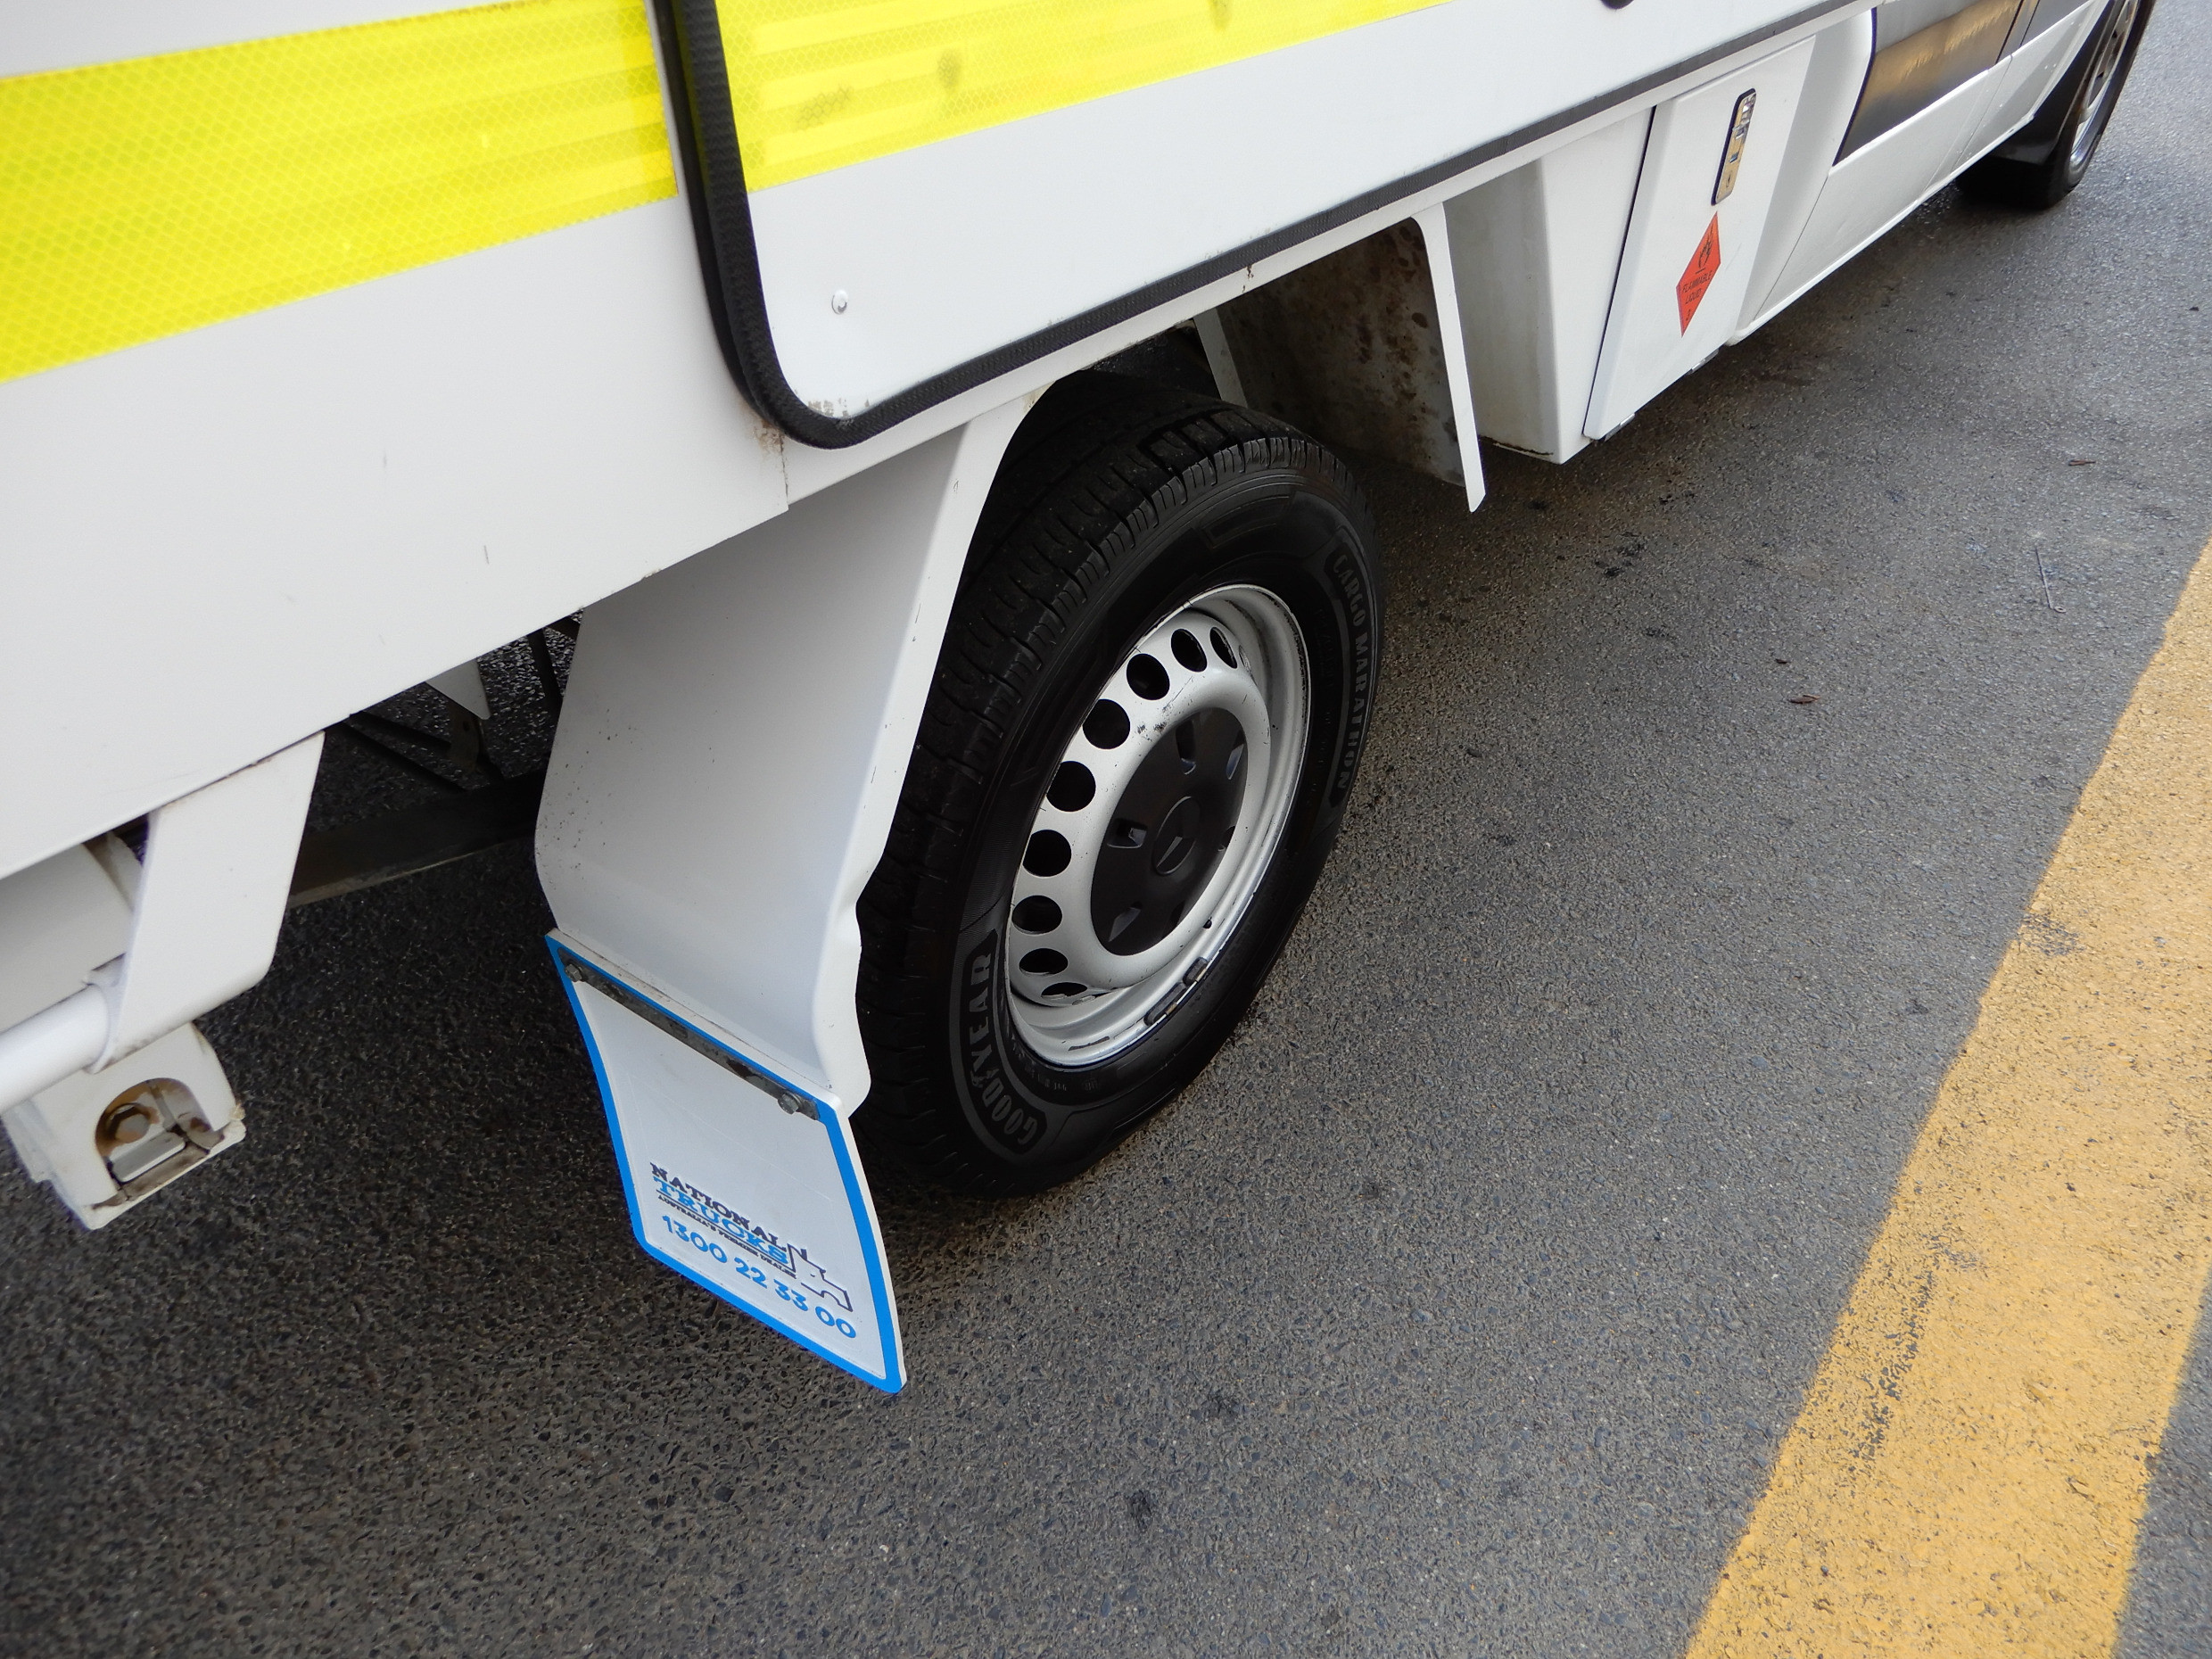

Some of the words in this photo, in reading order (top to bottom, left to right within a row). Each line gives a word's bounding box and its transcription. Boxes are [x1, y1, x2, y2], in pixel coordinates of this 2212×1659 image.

[1682, 270, 1713, 293] FLAMMABLE
[1685, 288, 1702, 304] LIQUID
[1333, 553, 1366, 627] CARGO
[1337, 631, 1369, 790] MARATHON
[970, 953, 1038, 1145] GOODYEAR
[649, 1161, 787, 1251] NATIONAL
[653, 1176, 788, 1265] TRUCKS
[658, 1194, 716, 1232] AUSTRALIA'S
[662, 1215, 727, 1263] 1300
[733, 1257, 768, 1289] 22
[773, 1278, 809, 1311] 33
[814, 1306, 856, 1338] 00
